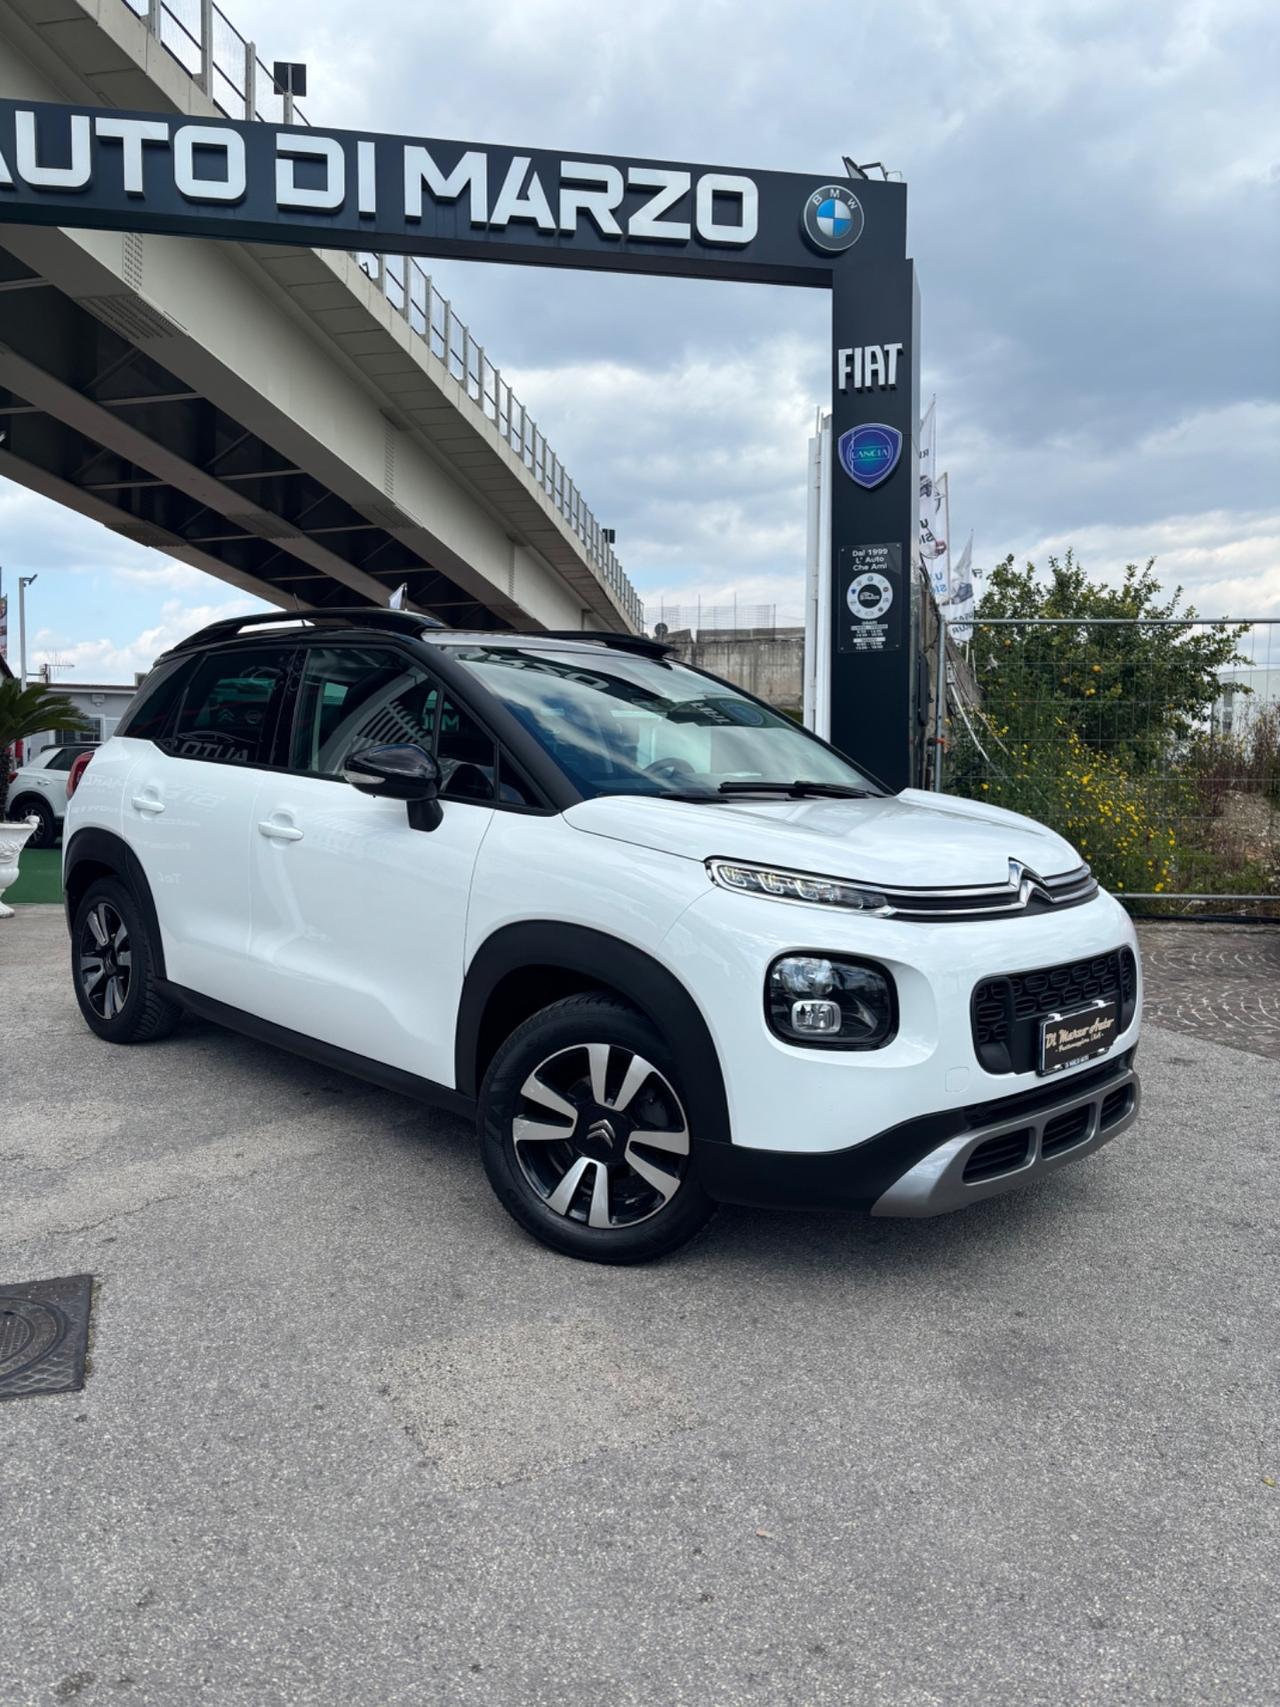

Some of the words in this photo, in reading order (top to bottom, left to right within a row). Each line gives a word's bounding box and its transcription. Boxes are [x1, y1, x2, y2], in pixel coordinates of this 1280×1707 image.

[0, 110, 246, 201] UTO
[275, 132, 376, 213] DI
[404, 144, 758, 244] MARZO
[812, 188, 858, 209] BMW
[838, 343, 903, 390] FIAT
[852, 549, 865, 557] Dal
